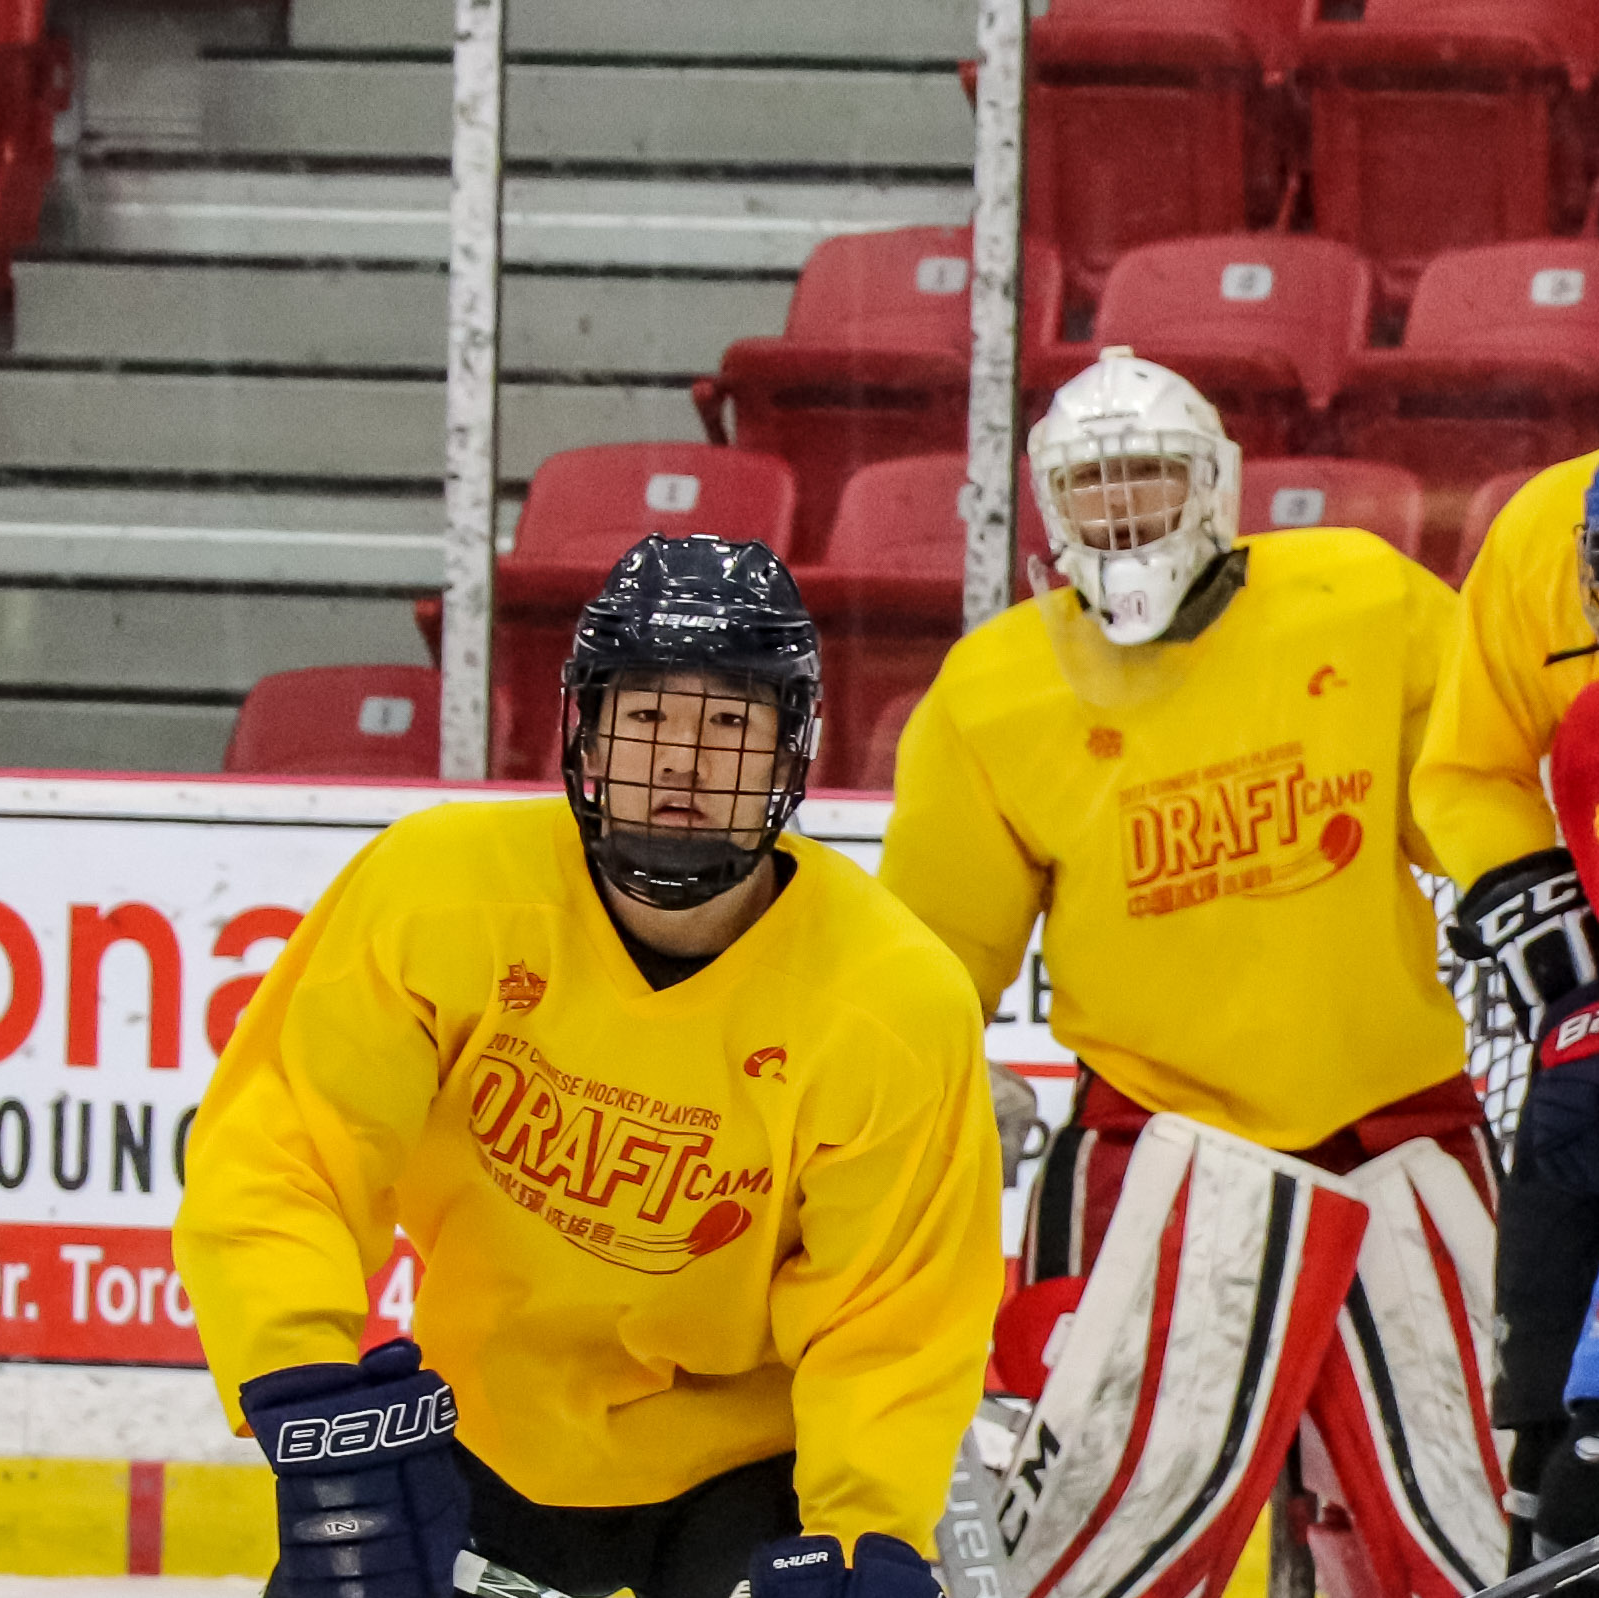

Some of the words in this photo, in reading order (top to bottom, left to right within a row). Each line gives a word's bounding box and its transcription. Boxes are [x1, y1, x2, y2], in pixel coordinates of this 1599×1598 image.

[1123, 762, 1305, 889] DRAFT
[1303, 768, 1374, 816] CAMP
[468, 1053, 715, 1225] DRAFT
[486, 1032, 529, 1058] 2017
[583, 1079, 651, 1113] HOCKEY
[649, 1098, 723, 1131] PLAYERS
